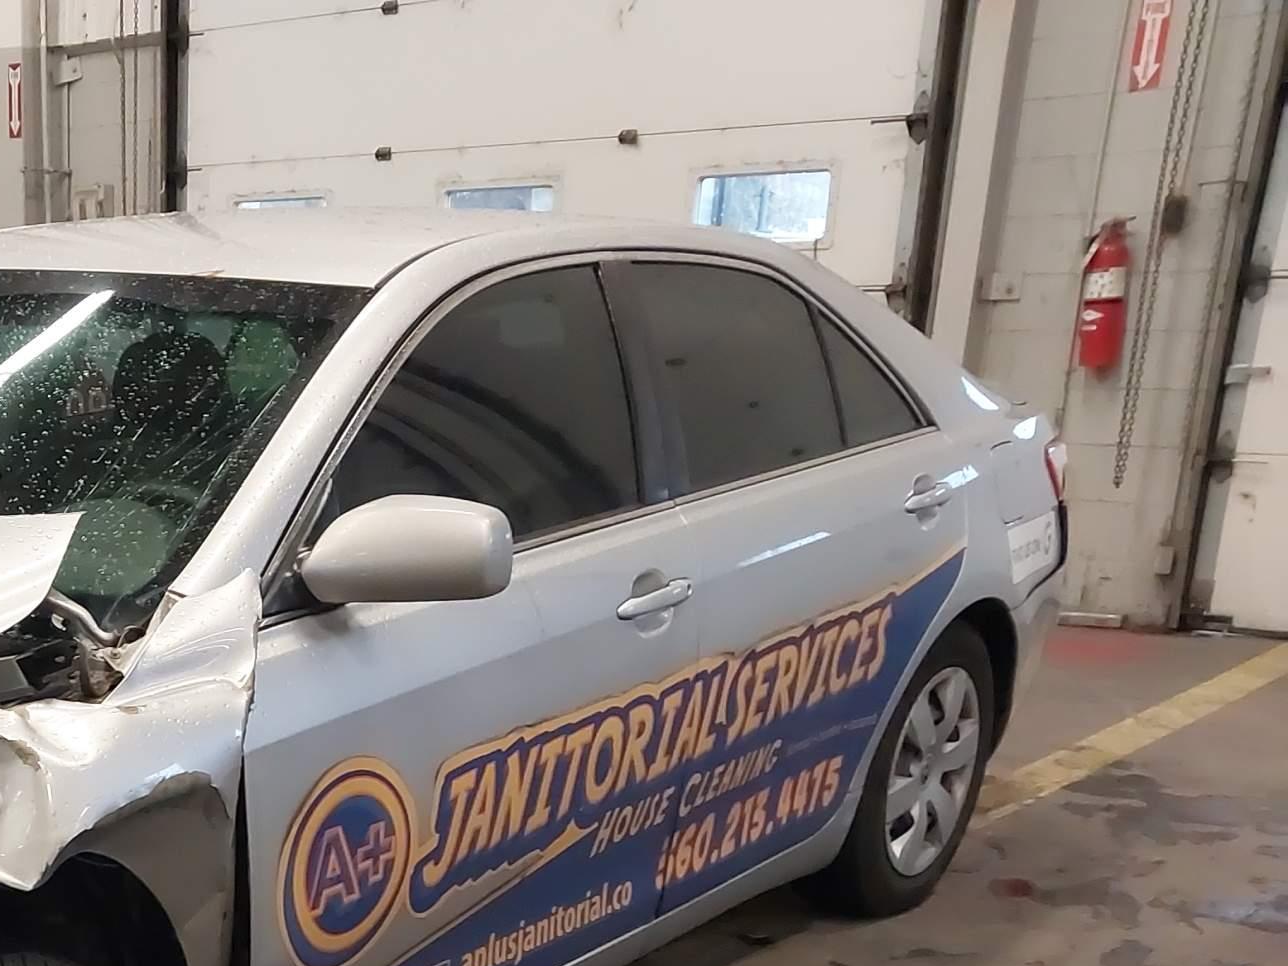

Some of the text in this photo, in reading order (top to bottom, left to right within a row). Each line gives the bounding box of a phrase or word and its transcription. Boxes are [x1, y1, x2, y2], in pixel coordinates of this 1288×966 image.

[422, 603, 893, 887] JANITORIAL SERVICES
[590, 739, 782, 857] HOUSE CLEANING
[308, 820, 396, 919] A+
